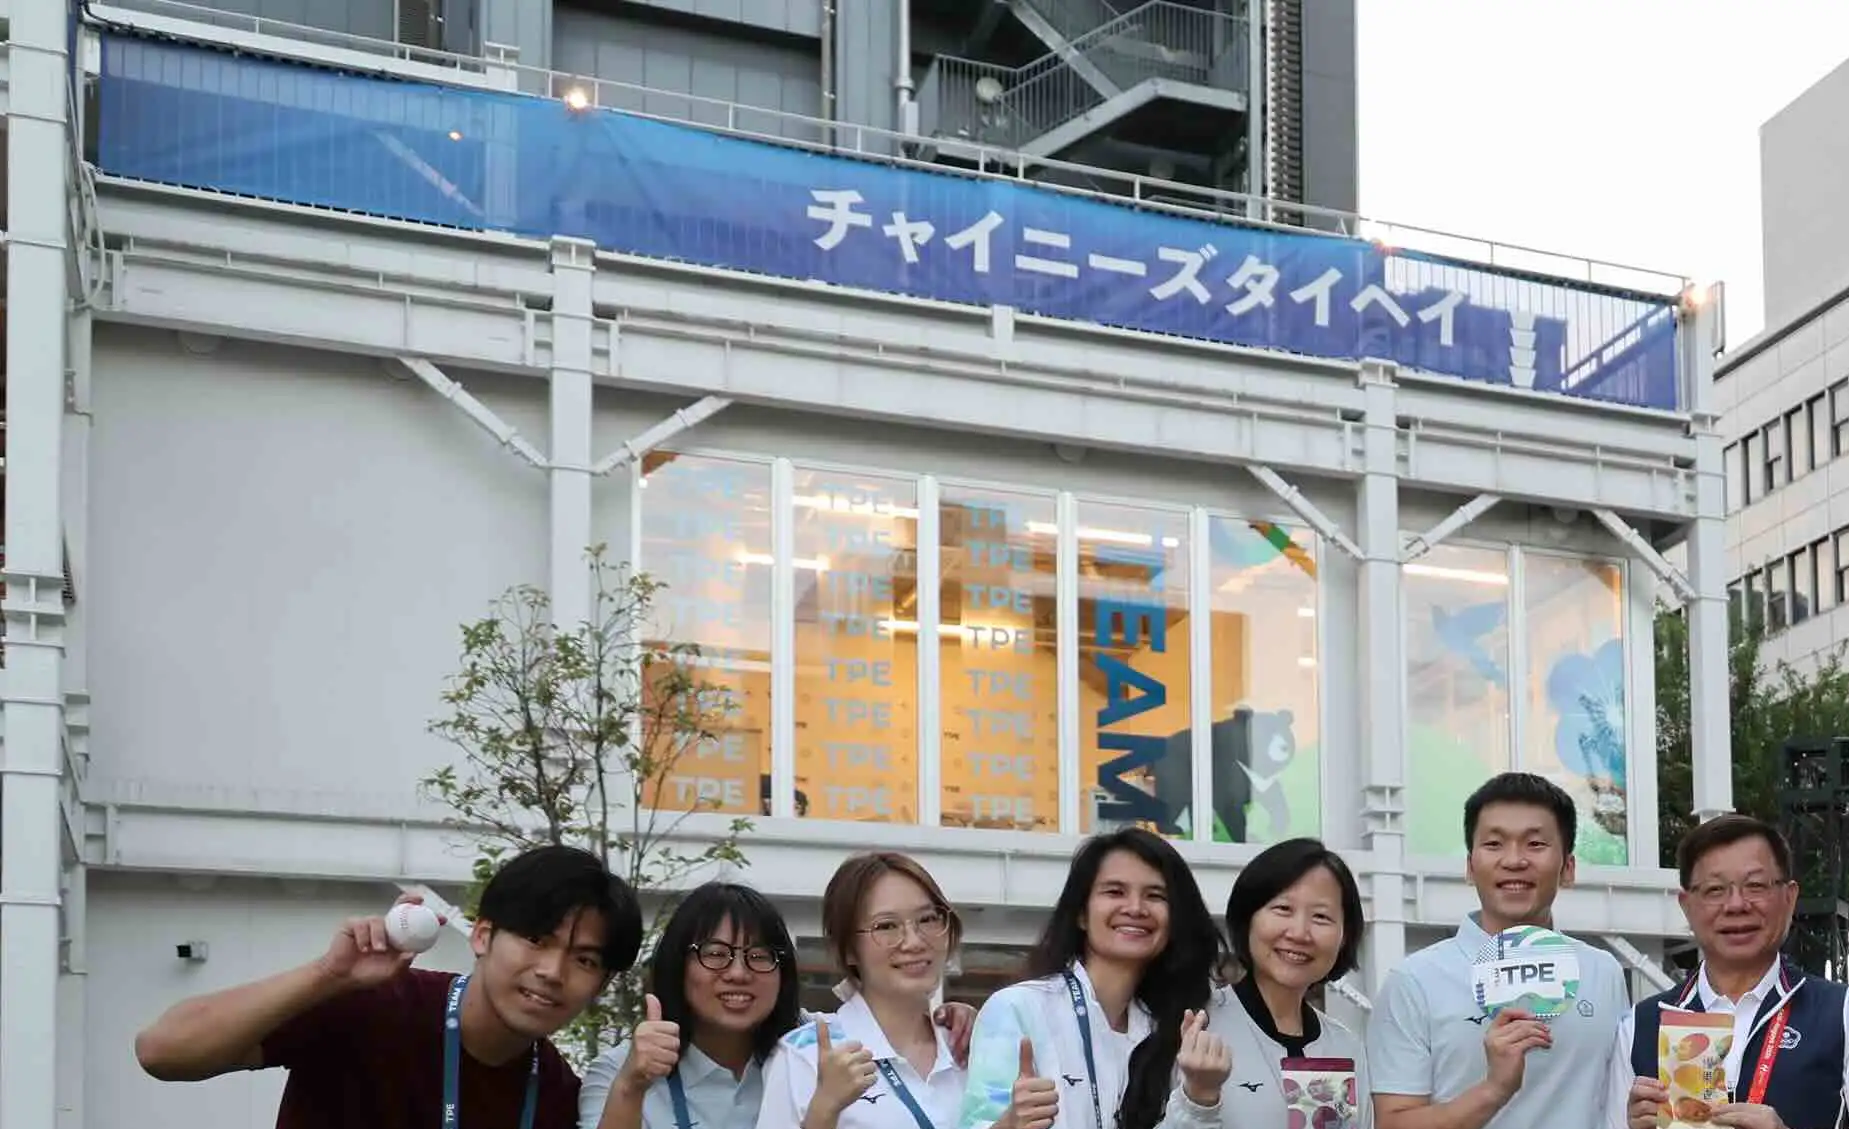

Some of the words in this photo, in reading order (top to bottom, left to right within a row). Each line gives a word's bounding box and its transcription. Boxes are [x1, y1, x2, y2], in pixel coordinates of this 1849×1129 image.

[965, 540, 1031, 572] TPE
[822, 570, 893, 599] TPE
[963, 584, 1031, 613] TPE
[819, 612, 892, 639] TPE
[967, 626, 1032, 655] TPE
[824, 657, 892, 688] TPE
[967, 669, 1035, 701] TPE
[1096, 524, 1169, 828] TEAM
[823, 697, 892, 729] TPE
[967, 710, 1035, 740] TPE
[823, 743, 892, 771] TPE
[967, 753, 1035, 781] TPE
[671, 777, 743, 806] TPE
[823, 786, 893, 815] TPE
[970, 793, 1033, 823] TPE
[1500, 962, 1556, 985] TPE
[445, 1103, 456, 1123] TPE
